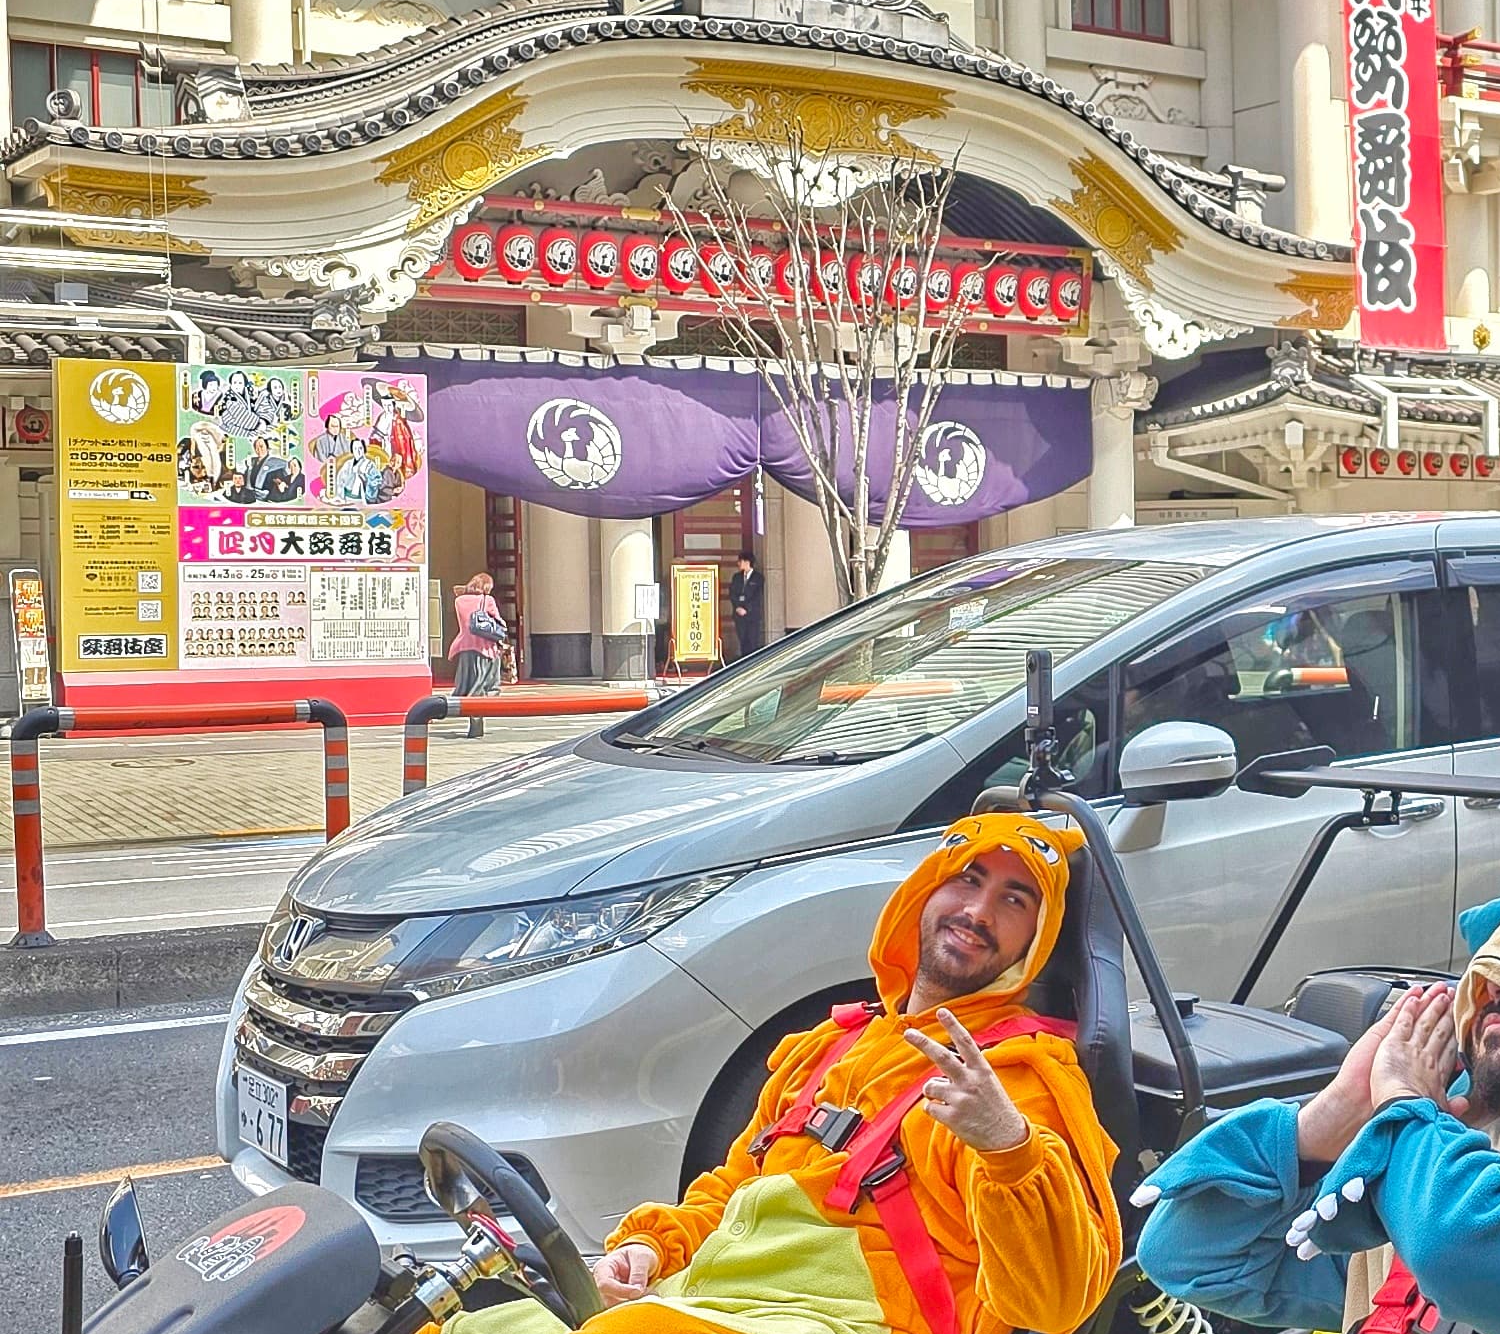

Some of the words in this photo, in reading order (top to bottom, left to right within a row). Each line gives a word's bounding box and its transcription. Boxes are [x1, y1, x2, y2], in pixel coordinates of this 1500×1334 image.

[80, 452, 172, 462] 0570-000-489
[218, 530, 392, 556] 四月大歌舞伎
